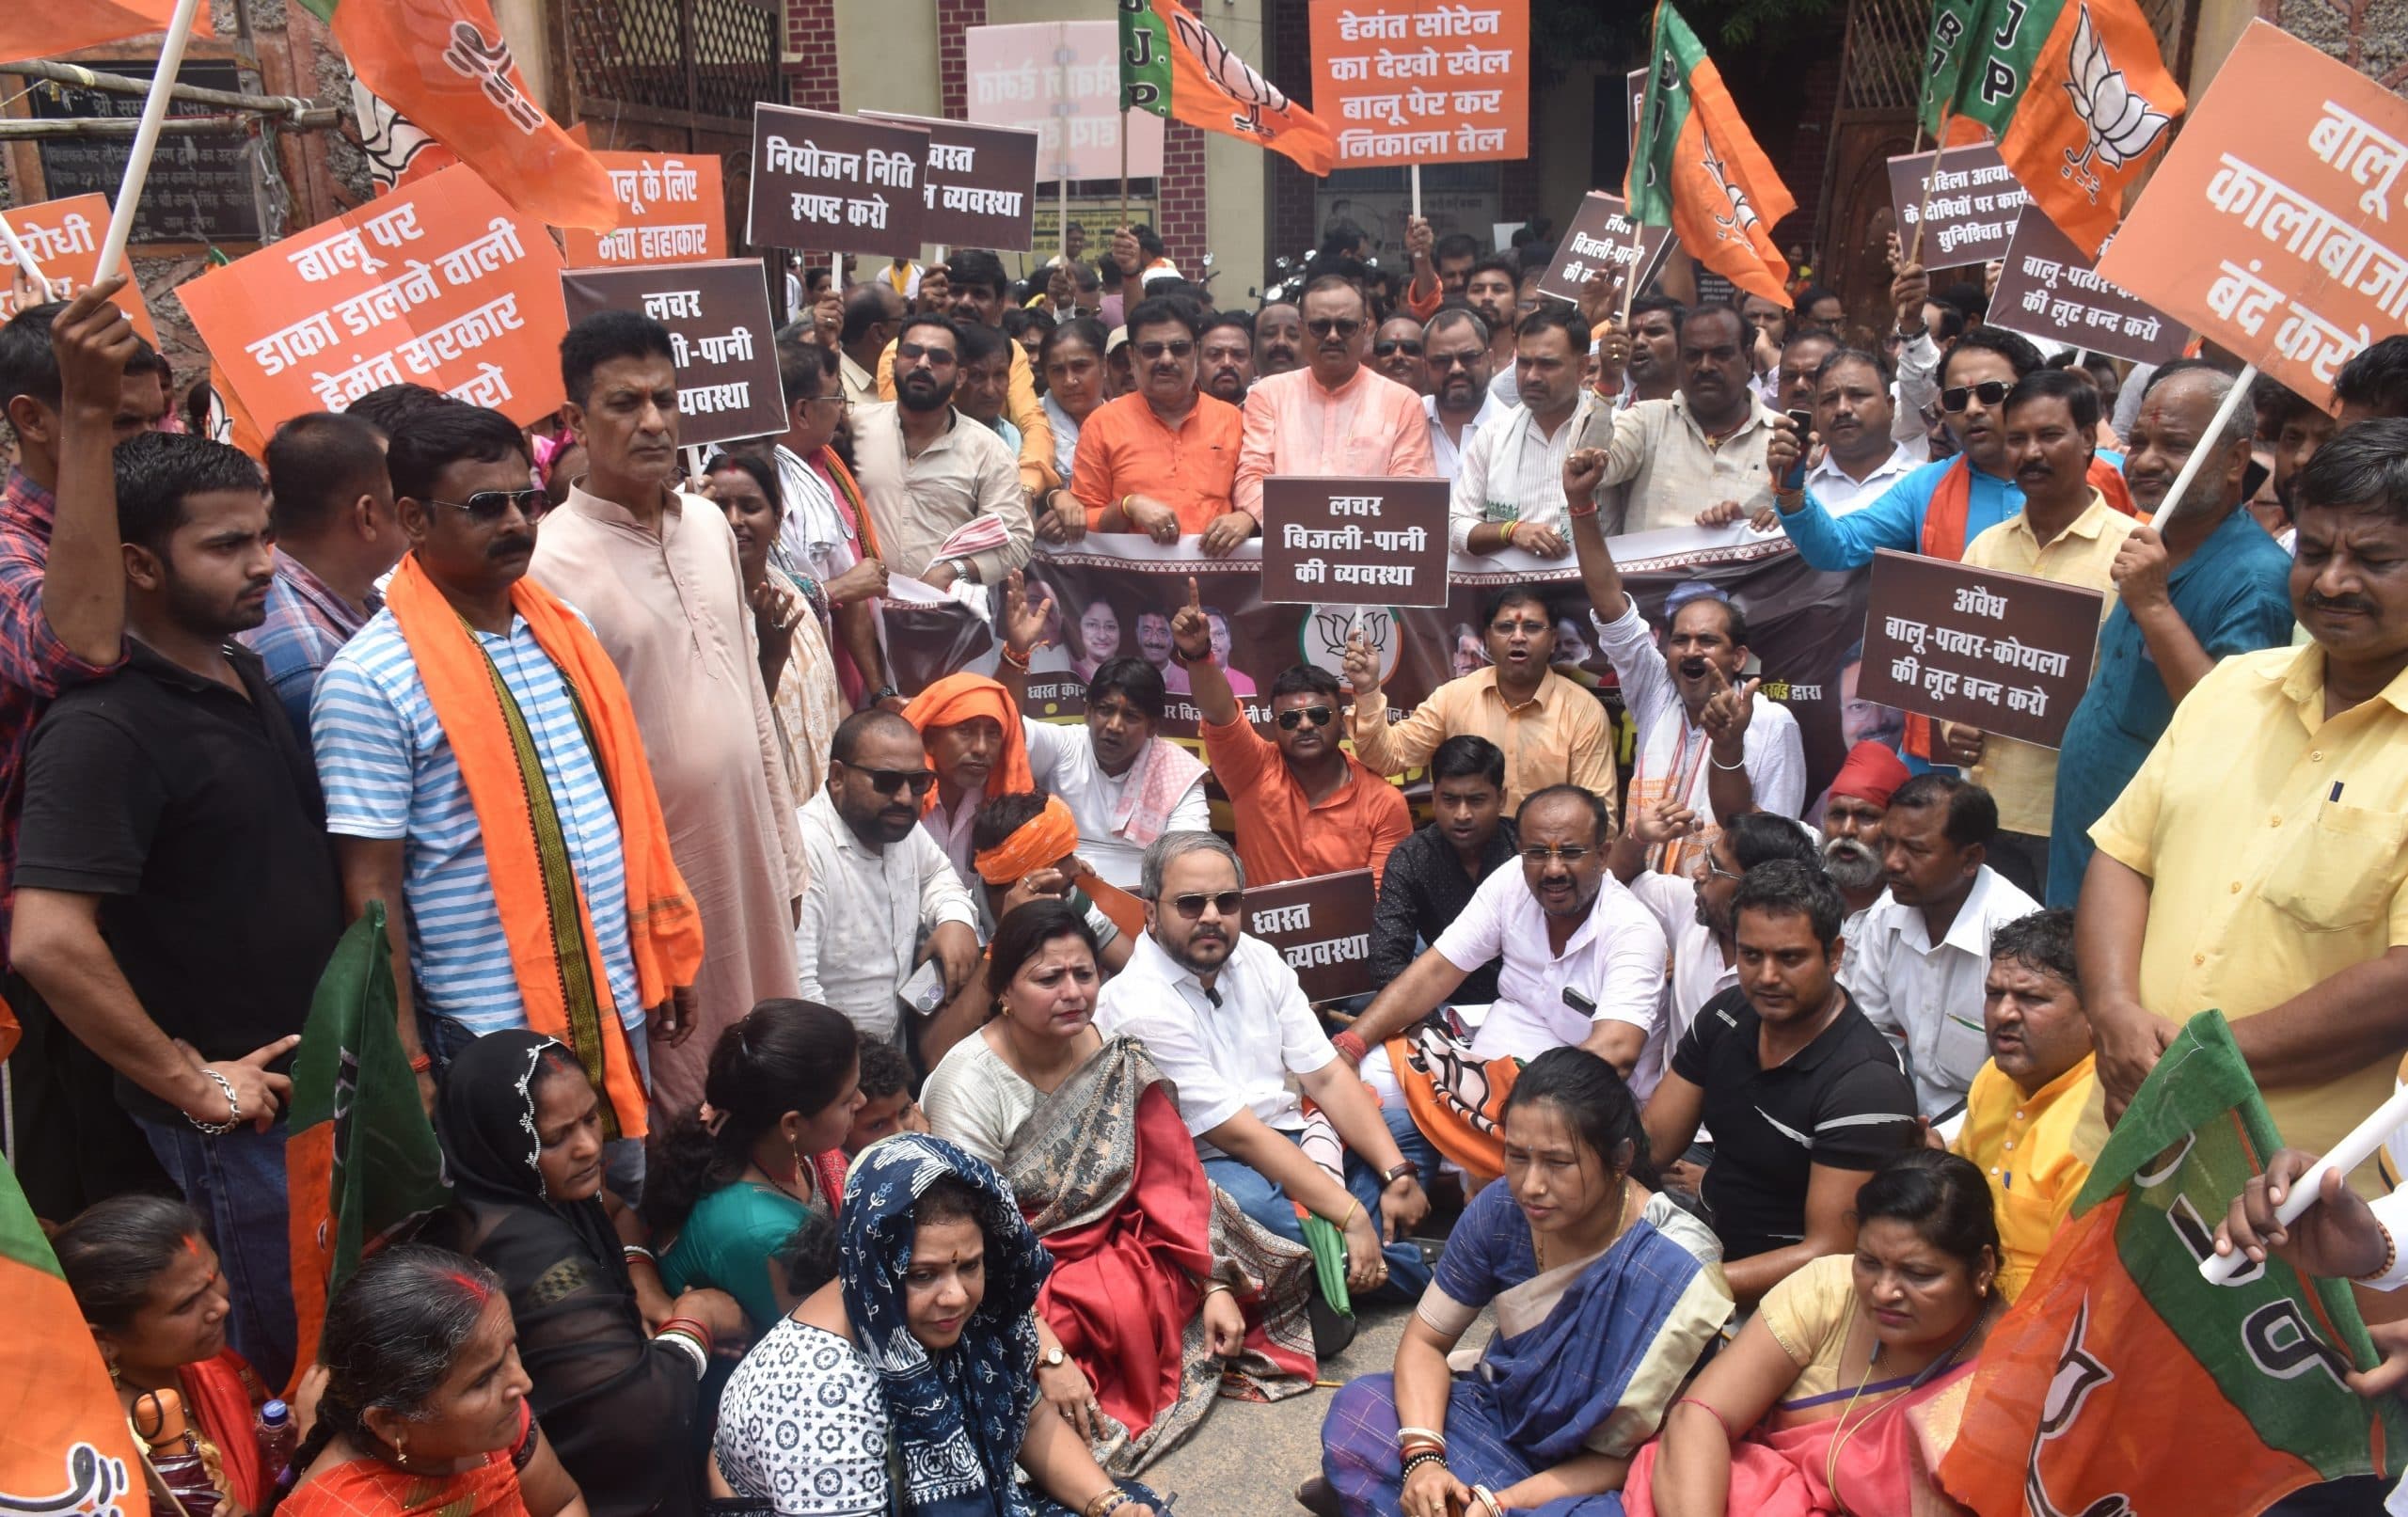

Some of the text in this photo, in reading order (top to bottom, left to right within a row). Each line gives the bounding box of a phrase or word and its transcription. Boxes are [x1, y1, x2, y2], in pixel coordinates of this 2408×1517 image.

[1337, 5, 1501, 41] हेमंत सोरेन
[1328, 43, 1513, 81] का देखो खेल
[1339, 87, 1503, 126] बालू पेर कर
[926, 143, 976, 172] वस्त
[1337, 123, 1507, 159] निकाला तेल
[767, 135, 916, 188] नियोजन निति
[2307, 99, 2408, 223] बालू
[607, 159, 698, 214] ालू के लिए
[943, 184, 1023, 217] व्यवस्था
[791, 192, 843, 225] स्पष्ट
[848, 193, 889, 229] करो
[1904, 203, 1921, 225] के
[1925, 194, 1972, 221] दोषियों
[1974, 195, 1995, 213] पर
[287, 201, 425, 283] बालू पर
[638, 223, 707, 259] हाहाकार
[1938, 219, 2003, 253] सुनिश्चित
[1562, 261, 1584, 282] की
[245, 216, 527, 376] डाका डालने वाली
[642, 291, 703, 321] लचर
[2207, 259, 2287, 338] बंद
[396, 292, 525, 375] सरकार
[2021, 289, 2162, 342] की लूट बन्द करो
[677, 381, 750, 416] यवस्था
[1328, 496, 1384, 516] लचर
[1283, 523, 1428, 552] बिजली-पानी
[1294, 558, 1415, 586] की व्यवस्था
[1953, 585, 2008, 620] अवैध
[1885, 615, 2070, 678] बालू-पत्थर-कोयला
[1791, 684, 1822, 701] द्वारा
[1891, 656, 2049, 717] की लूट बन्द करो
[1252, 903, 1311, 935] ध्वस्त
[1284, 933, 1370, 970] व्यवस्था
